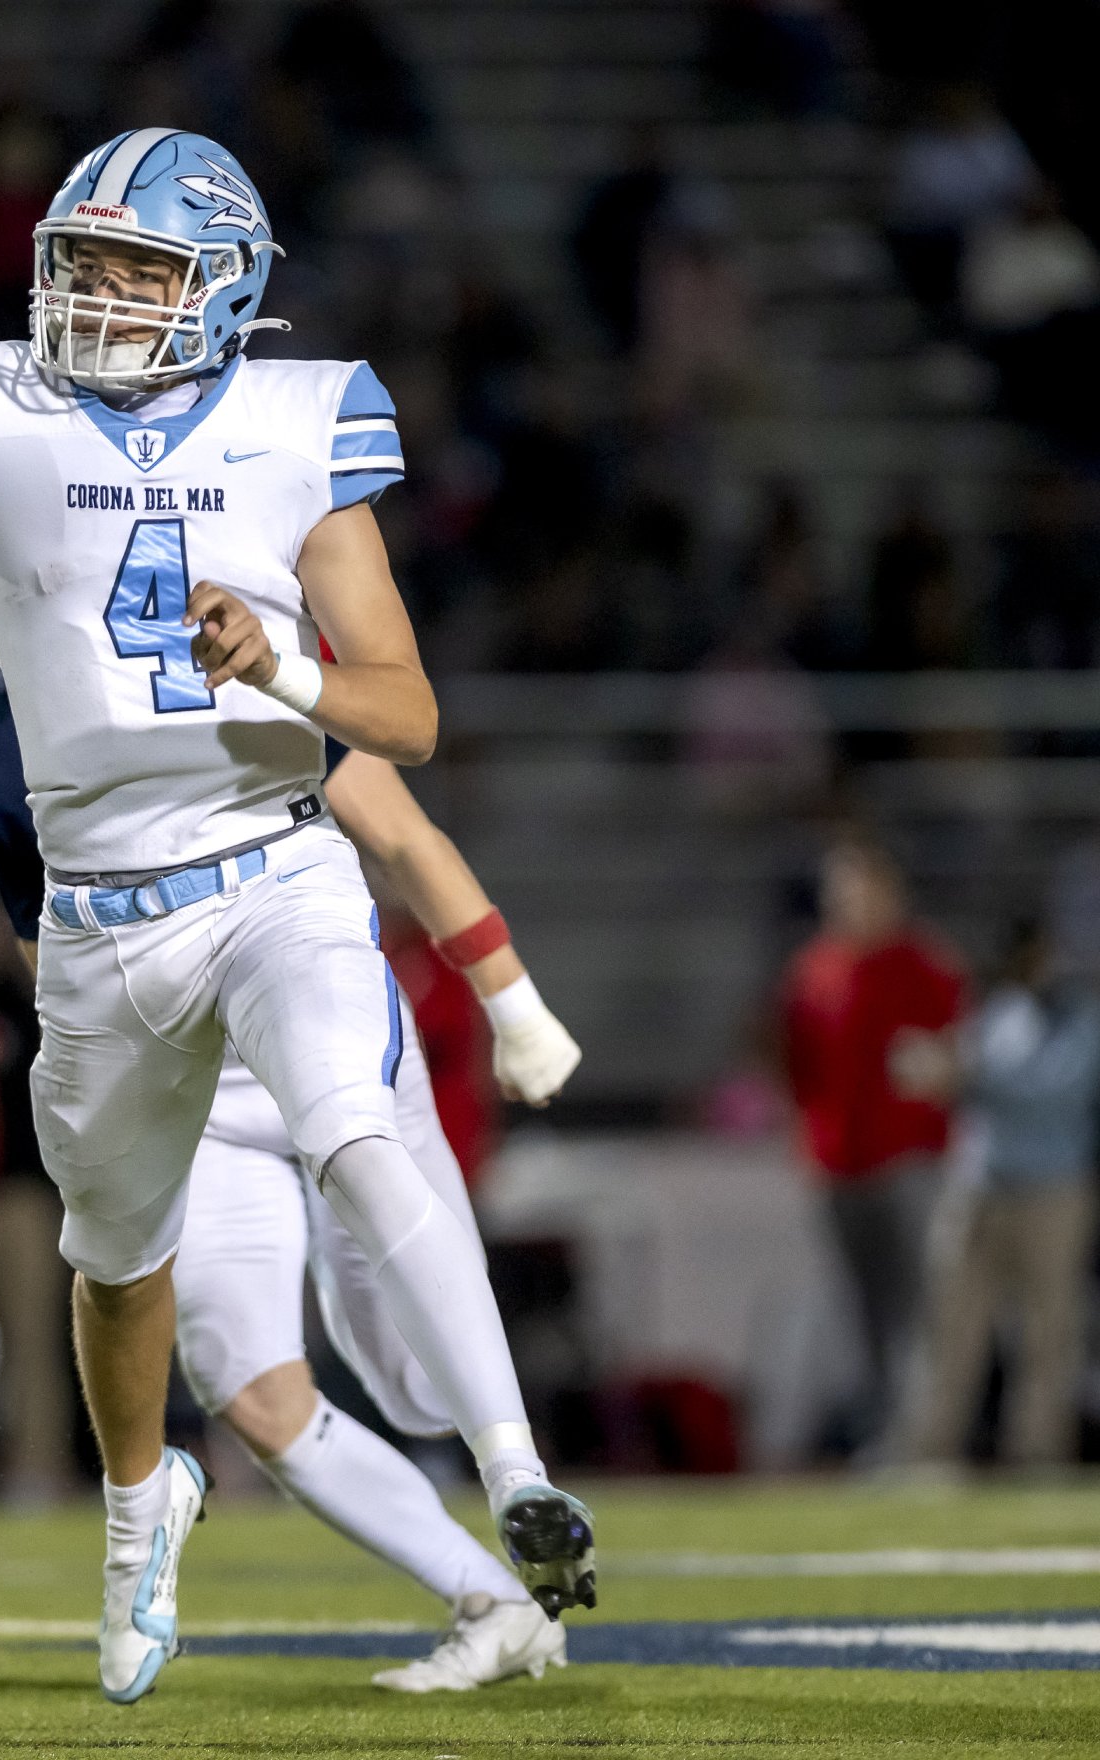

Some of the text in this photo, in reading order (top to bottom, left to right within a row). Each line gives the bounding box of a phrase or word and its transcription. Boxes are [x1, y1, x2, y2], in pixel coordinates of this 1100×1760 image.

[67, 484, 225, 512] CORONA DEL MAR
[103, 518, 216, 714] 4
[300, 801, 314, 816] M
